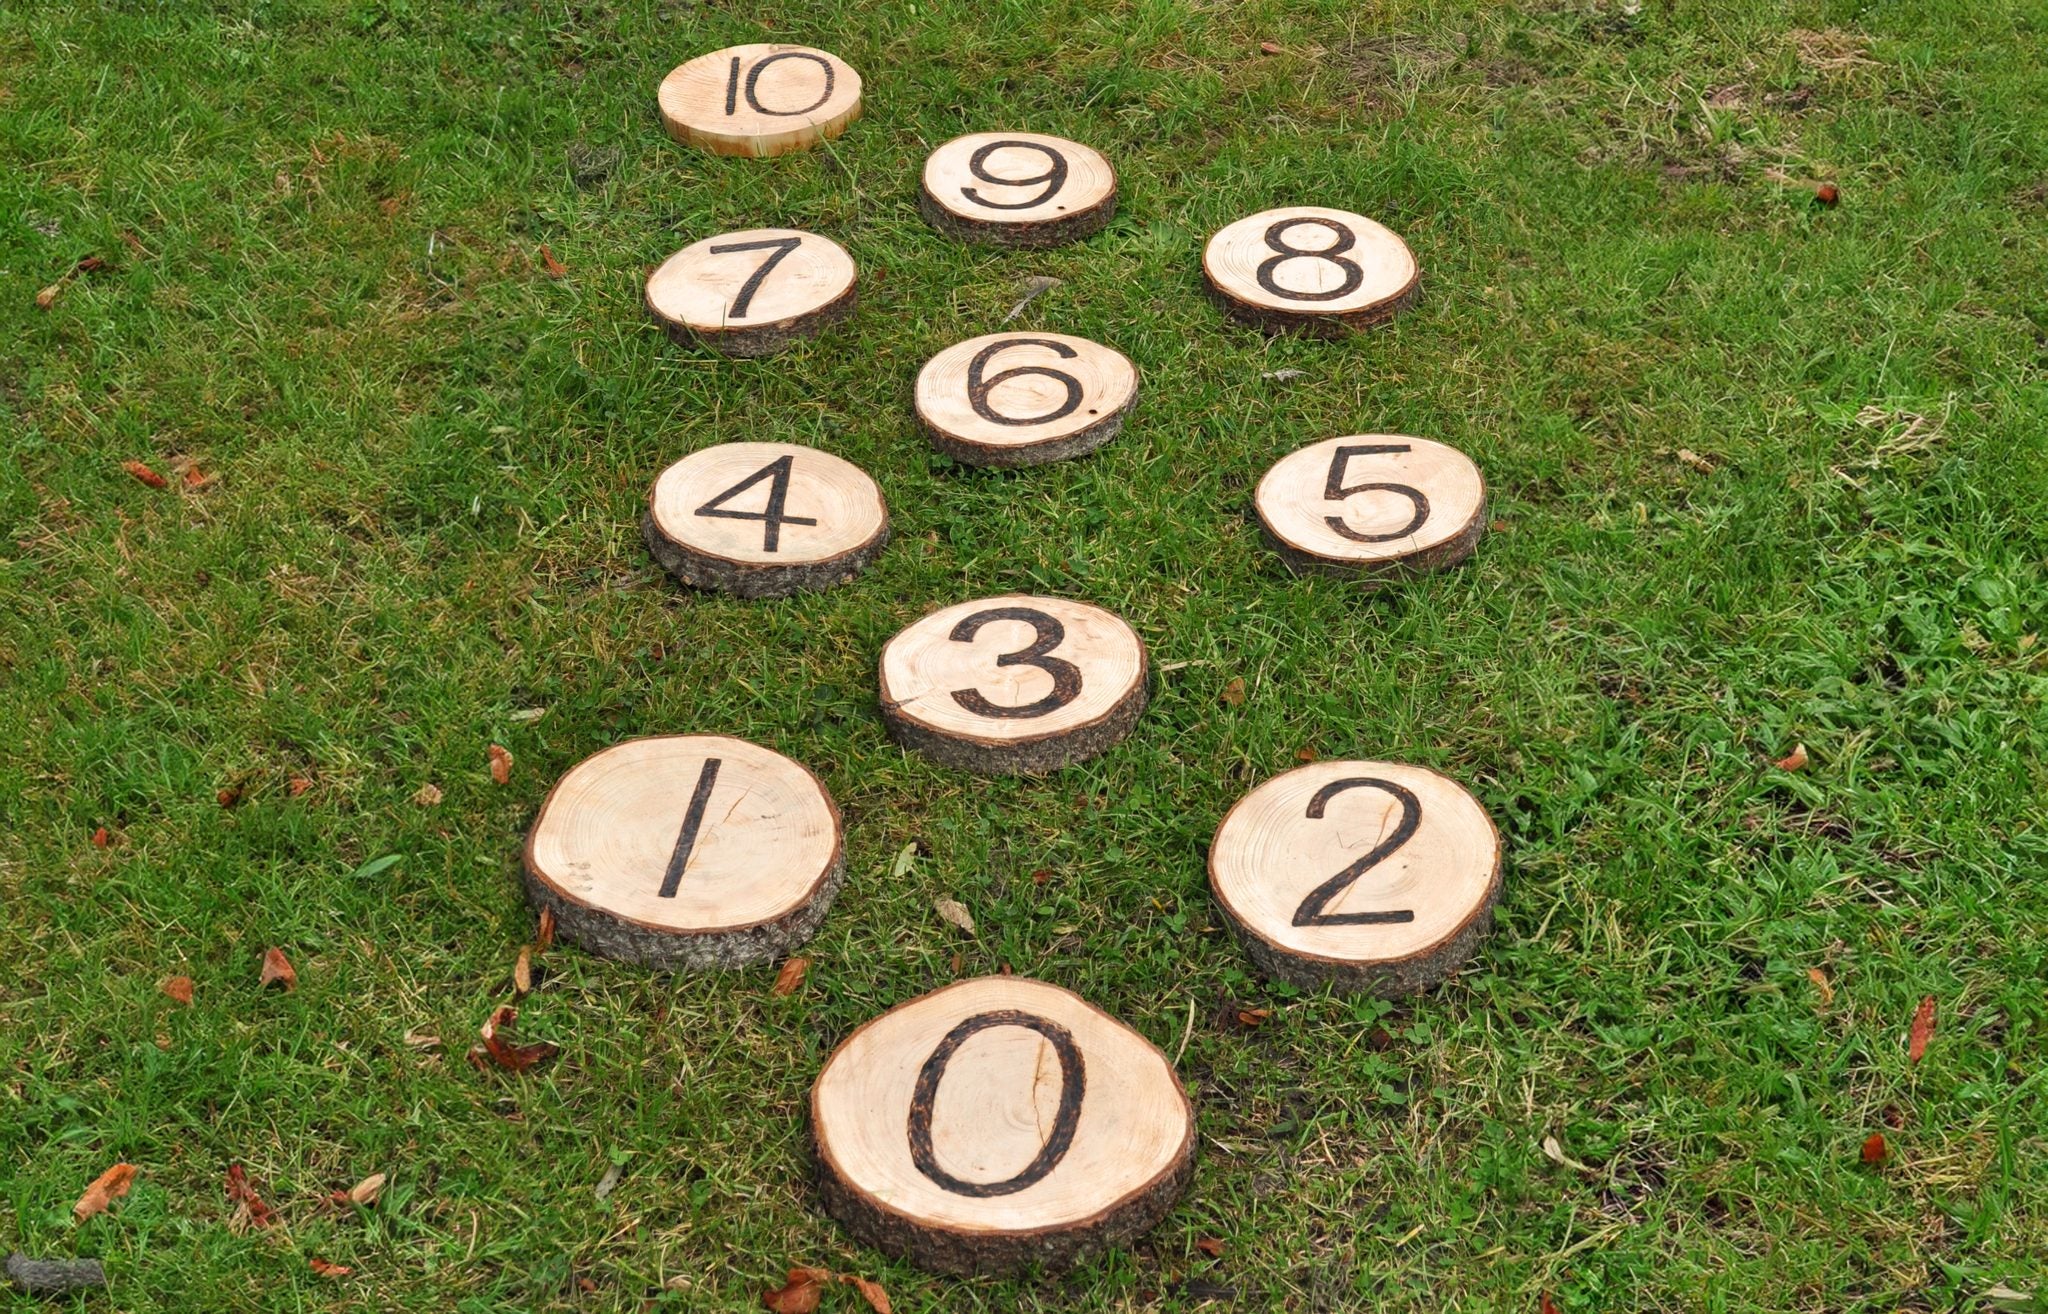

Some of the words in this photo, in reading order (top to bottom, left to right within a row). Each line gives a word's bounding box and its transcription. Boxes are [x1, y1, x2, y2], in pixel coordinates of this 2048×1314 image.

[725, 51, 836, 116] 10
[961, 141, 1067, 209] 9
[709, 236, 802, 319] 7
[1257, 216, 1364, 301] 8
[967, 338, 1084, 426] 6
[694, 456, 817, 552] 4
[1324, 445, 1429, 542] 5
[949, 607, 1083, 719] 3
[658, 758, 722, 898] 1
[1291, 777, 1421, 928] 2
[908, 1009, 1086, 1198] 0
